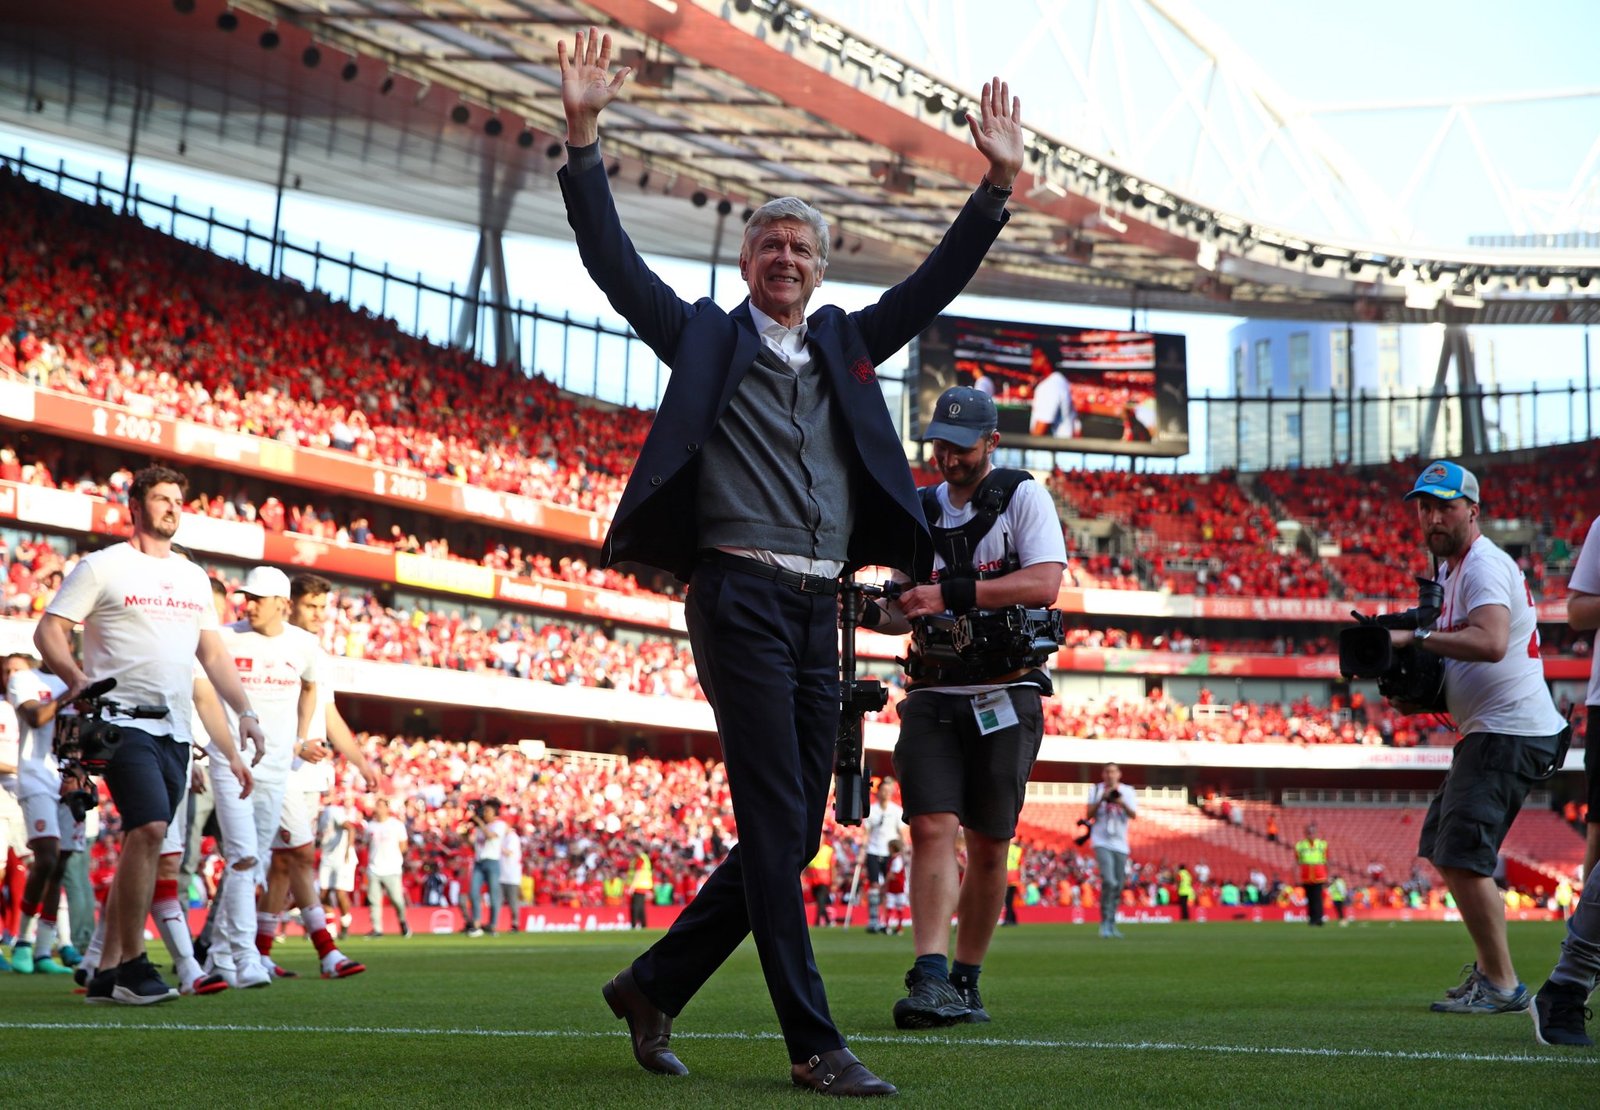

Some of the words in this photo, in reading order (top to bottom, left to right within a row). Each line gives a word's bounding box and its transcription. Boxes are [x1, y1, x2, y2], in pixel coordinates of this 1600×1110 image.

[114, 412, 162, 444] 2002
[123, 595, 163, 608] Merci
[240, 675, 261, 684] erci
